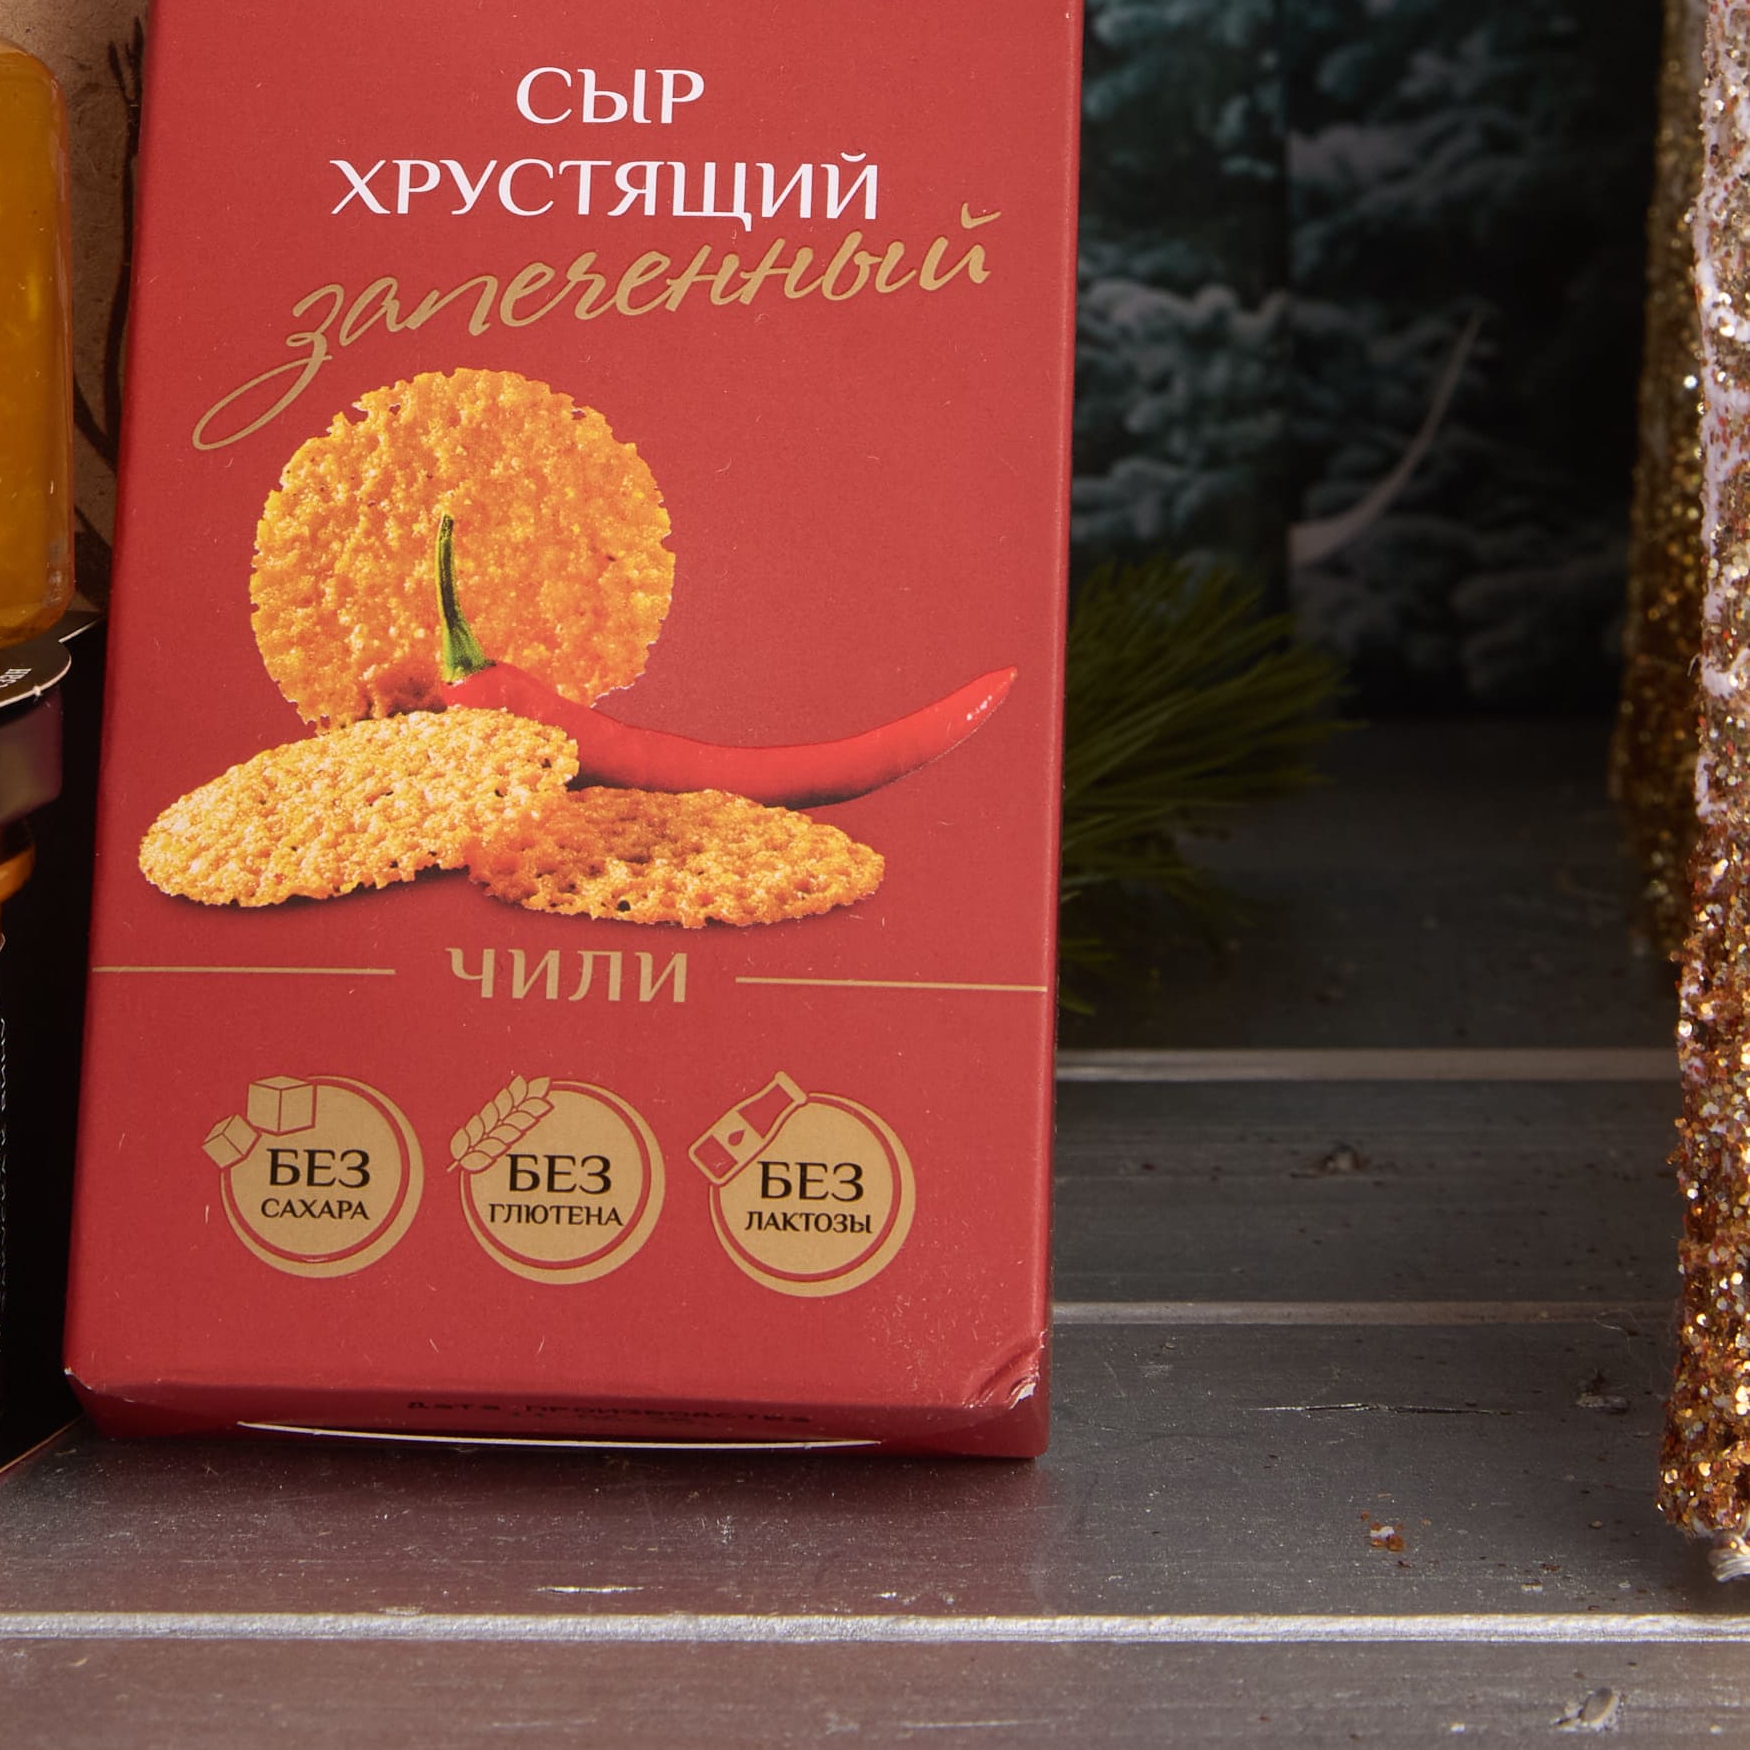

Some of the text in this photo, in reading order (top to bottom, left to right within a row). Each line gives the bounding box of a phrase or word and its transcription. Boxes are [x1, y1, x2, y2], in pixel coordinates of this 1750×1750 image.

[515, 66, 705, 125] СЫР
[329, 152, 879, 231] ХРУСТЯЩИЙ
[191, 202, 1002, 451] запеченный
[444, 946, 688, 1003] ЧИЛИ
[265, 1147, 372, 1189] БЕЗ
[505, 1153, 613, 1195] БЕЗ
[757, 1160, 866, 1202] БЕЗ
[260, 1196, 371, 1221] САХАРА
[487, 1202, 625, 1228] ГЛЮТЕНА
[744, 1209, 874, 1235] ЛАКТОЗЫ
